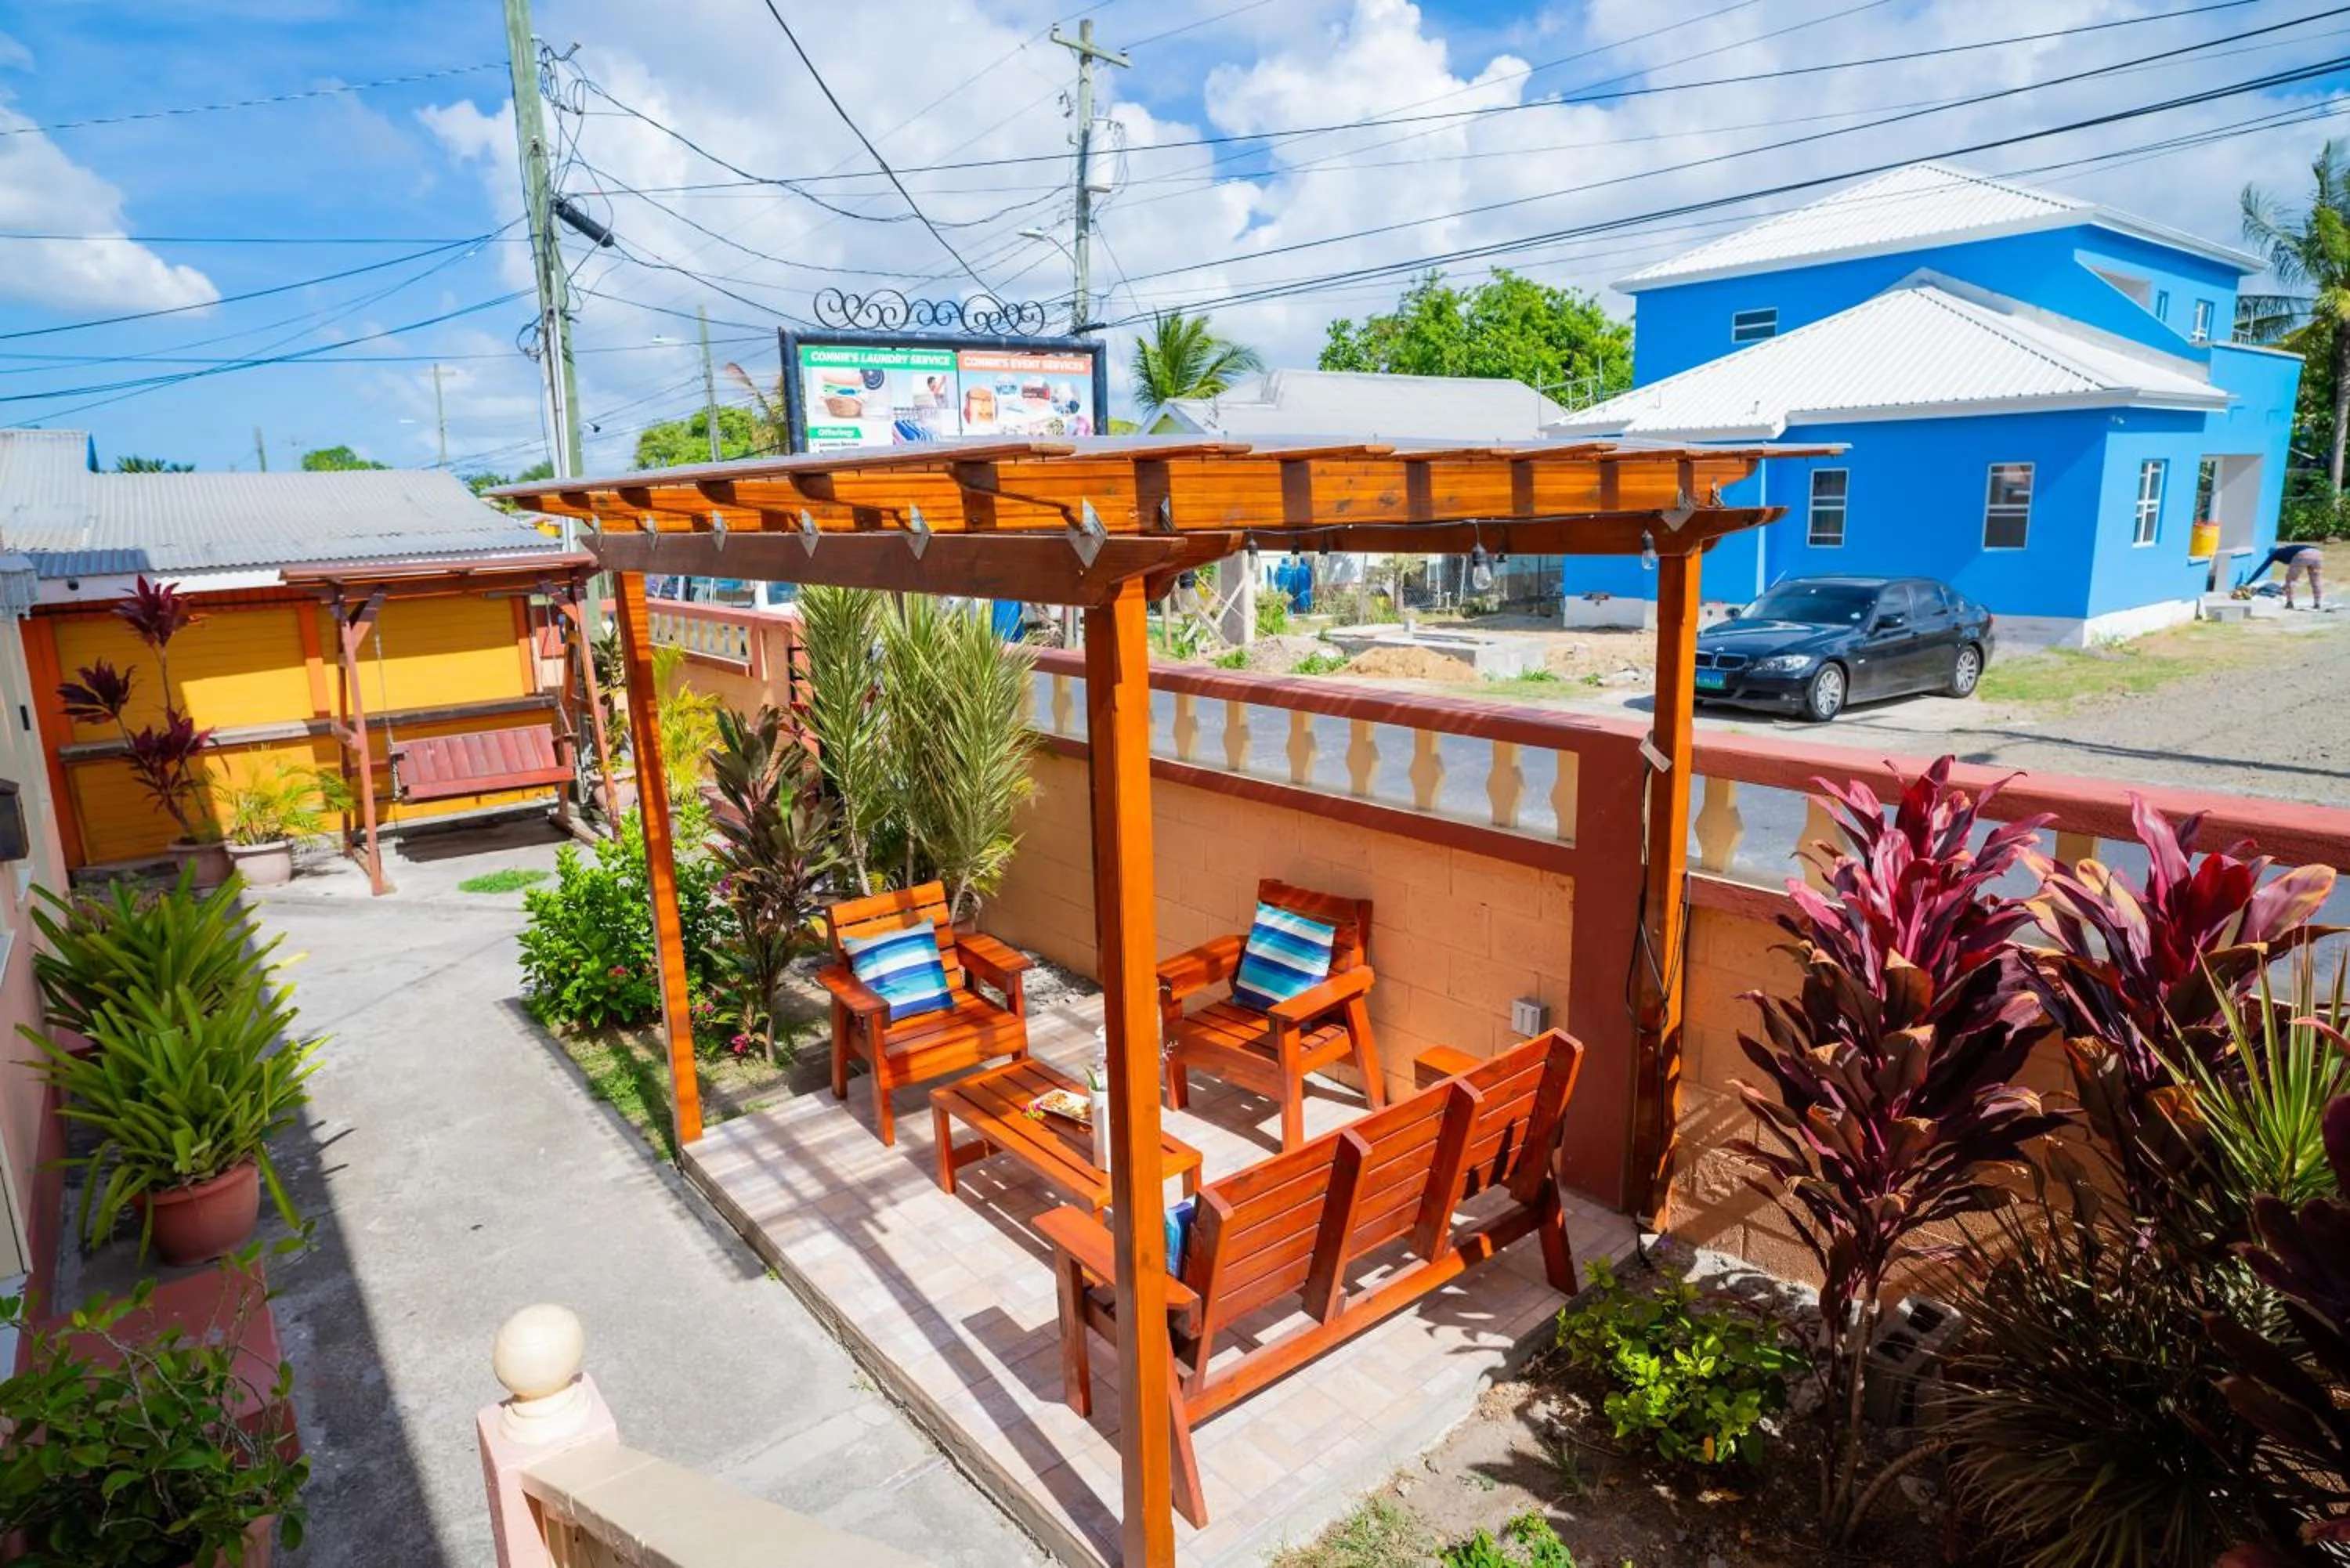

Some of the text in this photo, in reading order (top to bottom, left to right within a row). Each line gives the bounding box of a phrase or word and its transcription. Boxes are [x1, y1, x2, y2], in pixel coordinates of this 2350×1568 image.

[861, 352, 909, 364] LAUNDRY
[910, 354, 950, 366] SERVICE
[1010, 358, 1040, 369] EVENT
